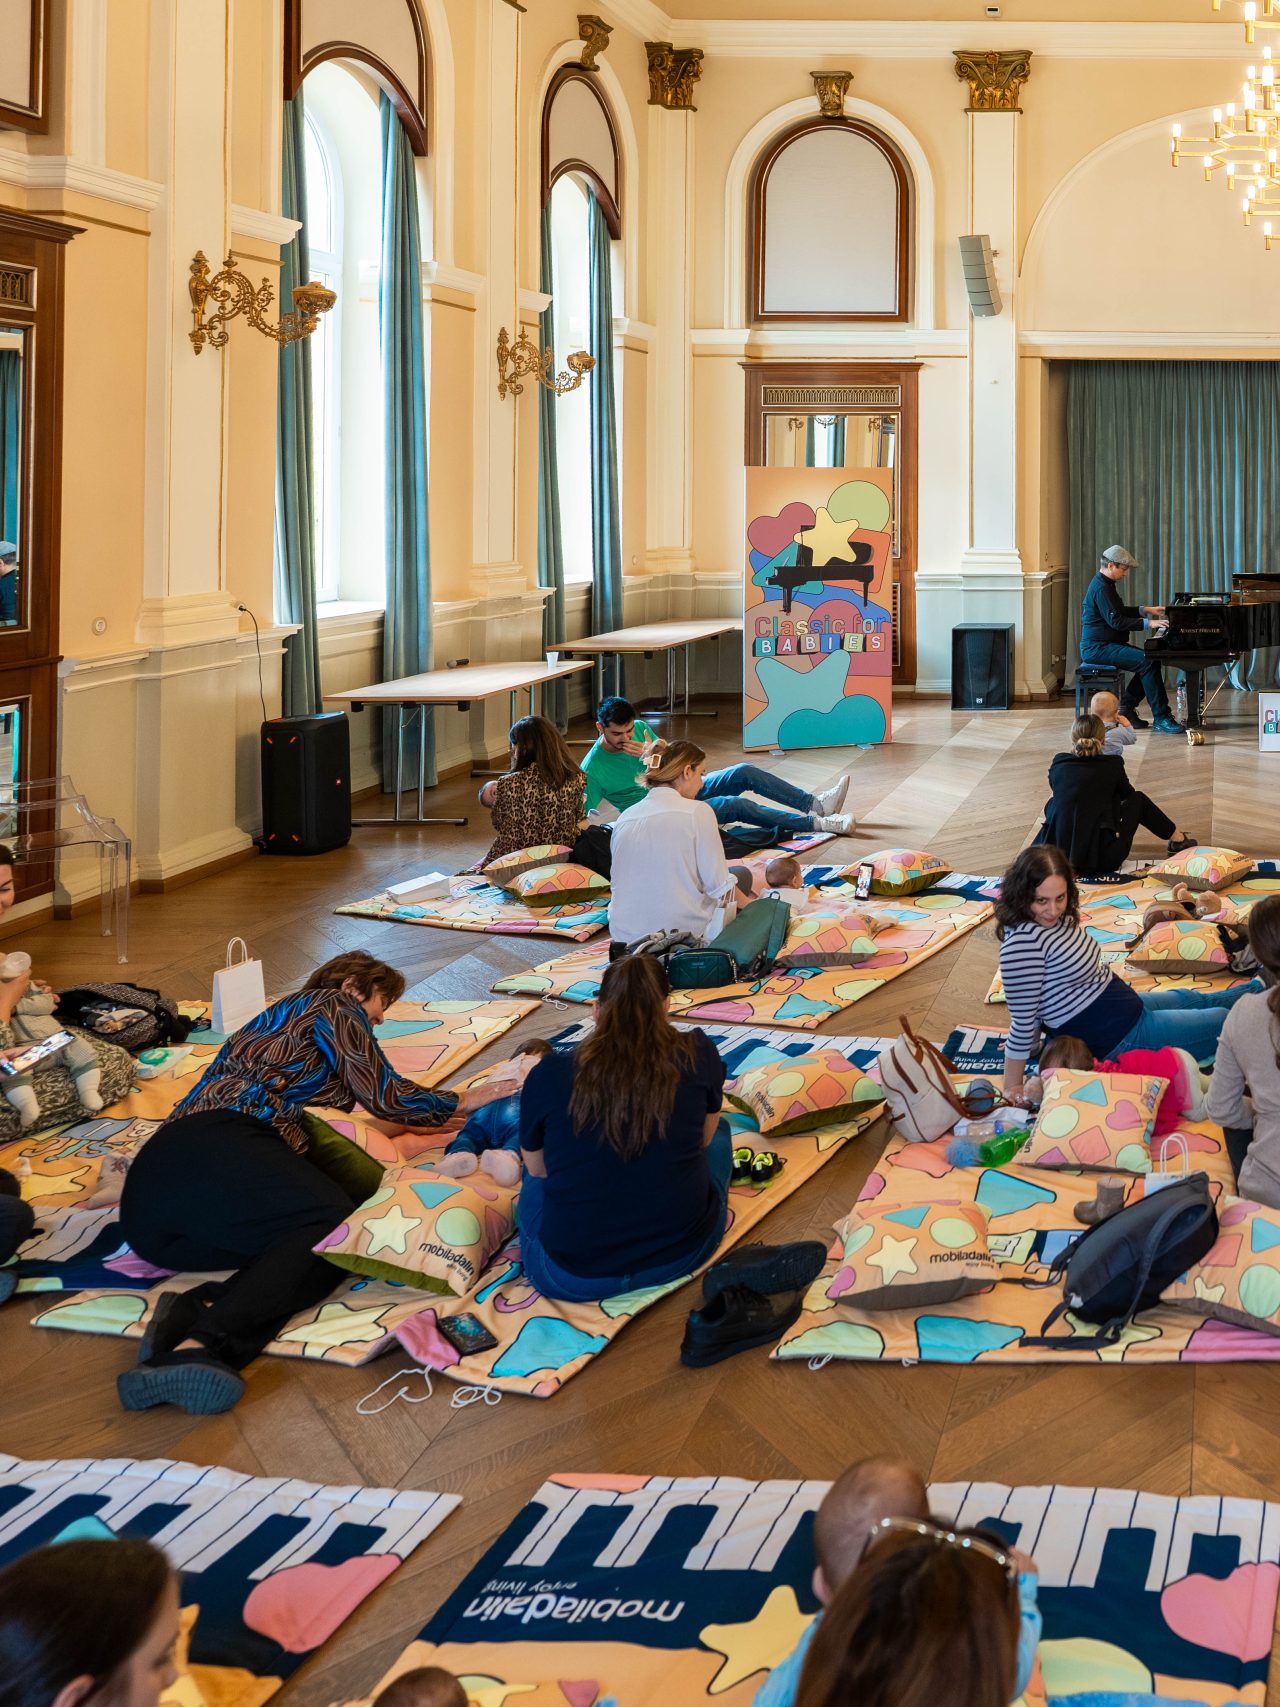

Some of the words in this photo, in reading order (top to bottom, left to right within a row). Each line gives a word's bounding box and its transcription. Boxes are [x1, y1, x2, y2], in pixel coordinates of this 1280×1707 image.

[755, 615, 846, 637] Classic
[853, 615, 887, 634] for
[757, 634, 883, 655] BABIES
[418, 1242, 475, 1277] mobiladalin
[481, 1579, 527, 1594] living
[528, 1579, 578, 1593] enjoy
[462, 1593, 686, 1624] mobiladalin
